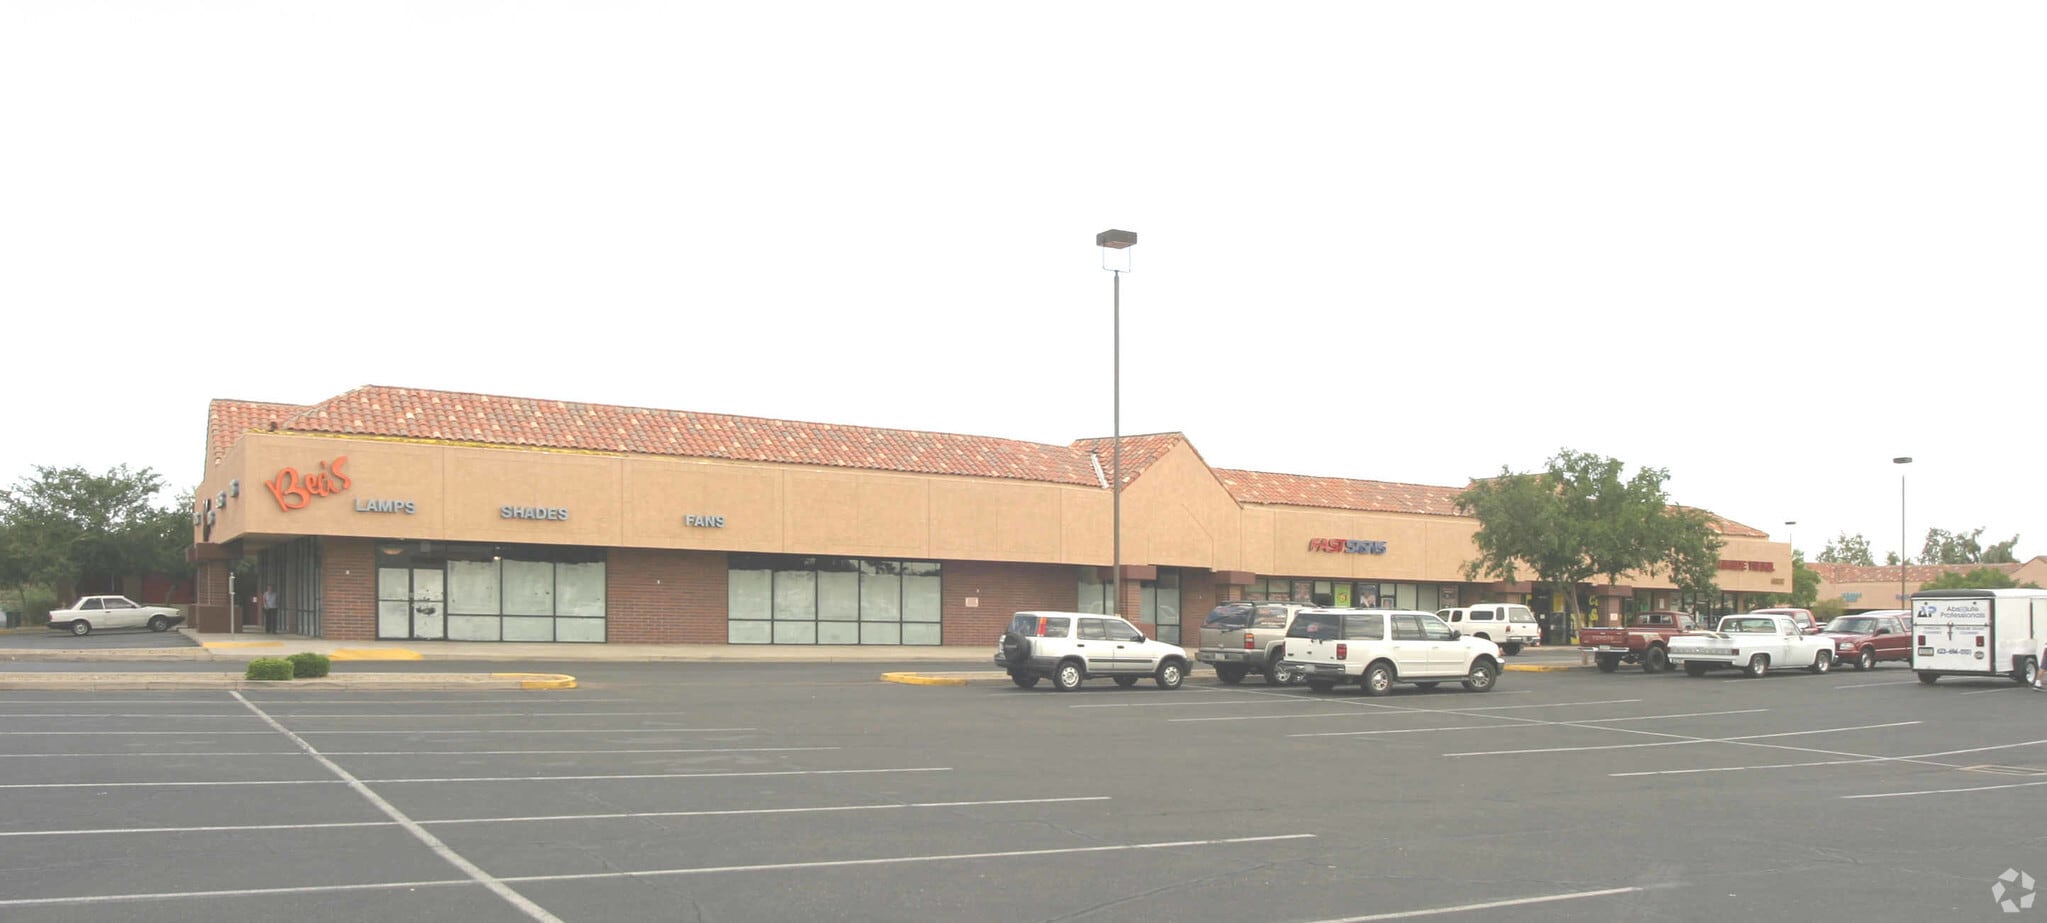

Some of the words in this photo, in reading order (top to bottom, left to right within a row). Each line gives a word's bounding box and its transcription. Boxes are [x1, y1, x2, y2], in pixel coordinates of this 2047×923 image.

[354, 498, 416, 514] LAMPS
[500, 505, 568, 521] SHADES
[685, 514, 725, 528] FANS
